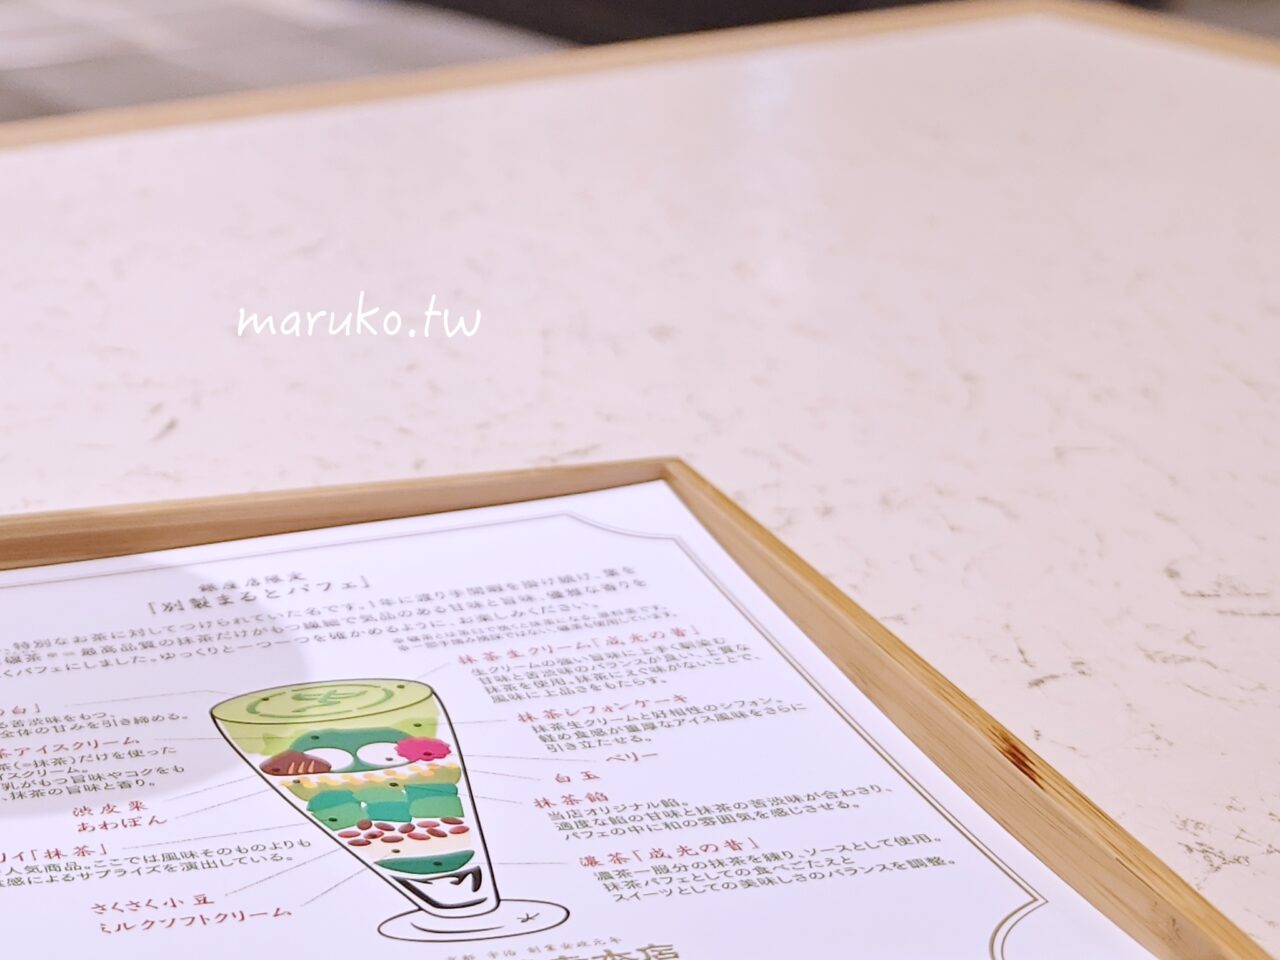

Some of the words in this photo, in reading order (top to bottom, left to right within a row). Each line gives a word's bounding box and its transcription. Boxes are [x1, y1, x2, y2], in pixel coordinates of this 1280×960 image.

[550, 768, 603, 784] 白玉
[529, 789, 612, 810] 抹茶餡
[88, 892, 216, 916] さくさく小豆
[99, 904, 294, 935] ミルクソフトクリーム
